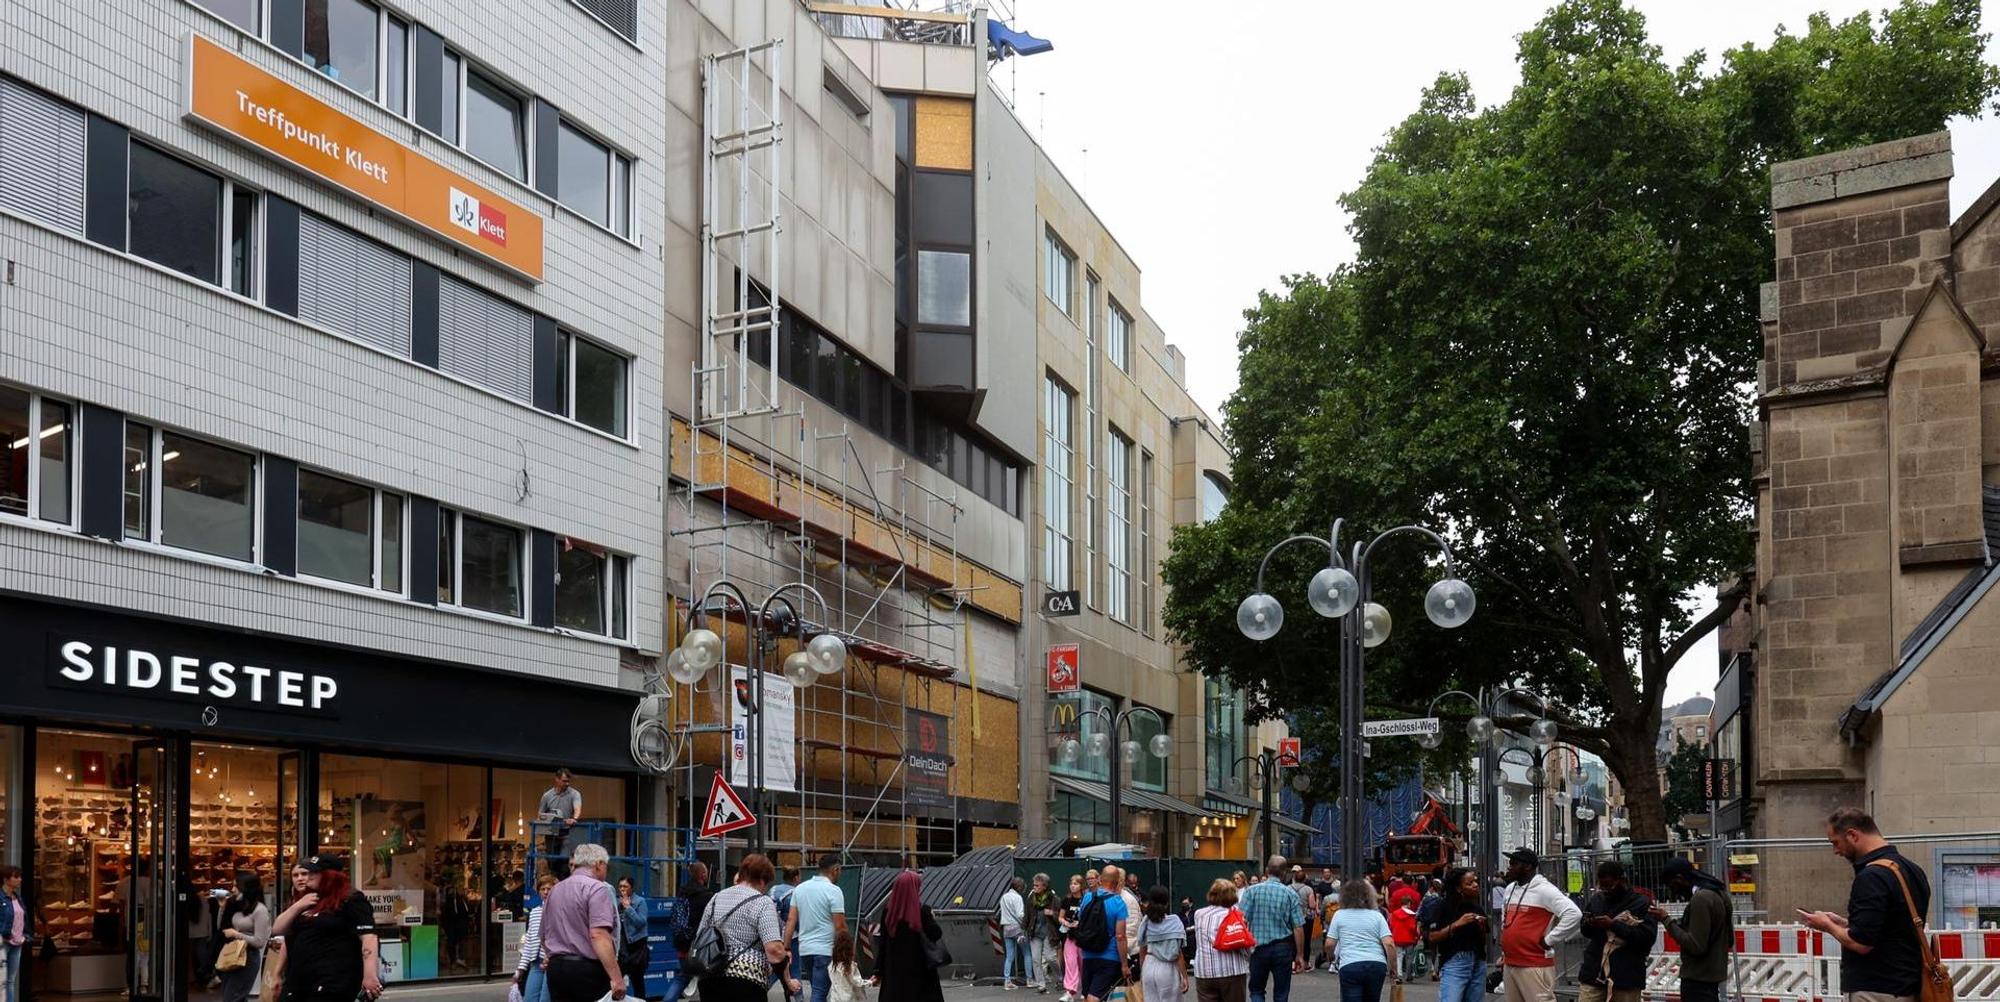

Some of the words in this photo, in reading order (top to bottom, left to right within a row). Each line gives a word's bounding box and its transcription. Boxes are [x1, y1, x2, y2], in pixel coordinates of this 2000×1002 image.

[236, 90, 341, 160] Treffpunkt
[345, 147, 390, 184] Klett
[479, 215, 507, 241] Klett
[1048, 595, 1074, 612] C&A
[59, 640, 338, 710] SIDESTEP
[1365, 720, 1437, 735] Ina-Gschlössl-Weg
[909, 755, 948, 772] DeinDach
[1705, 777, 1713, 798] CALVIN
